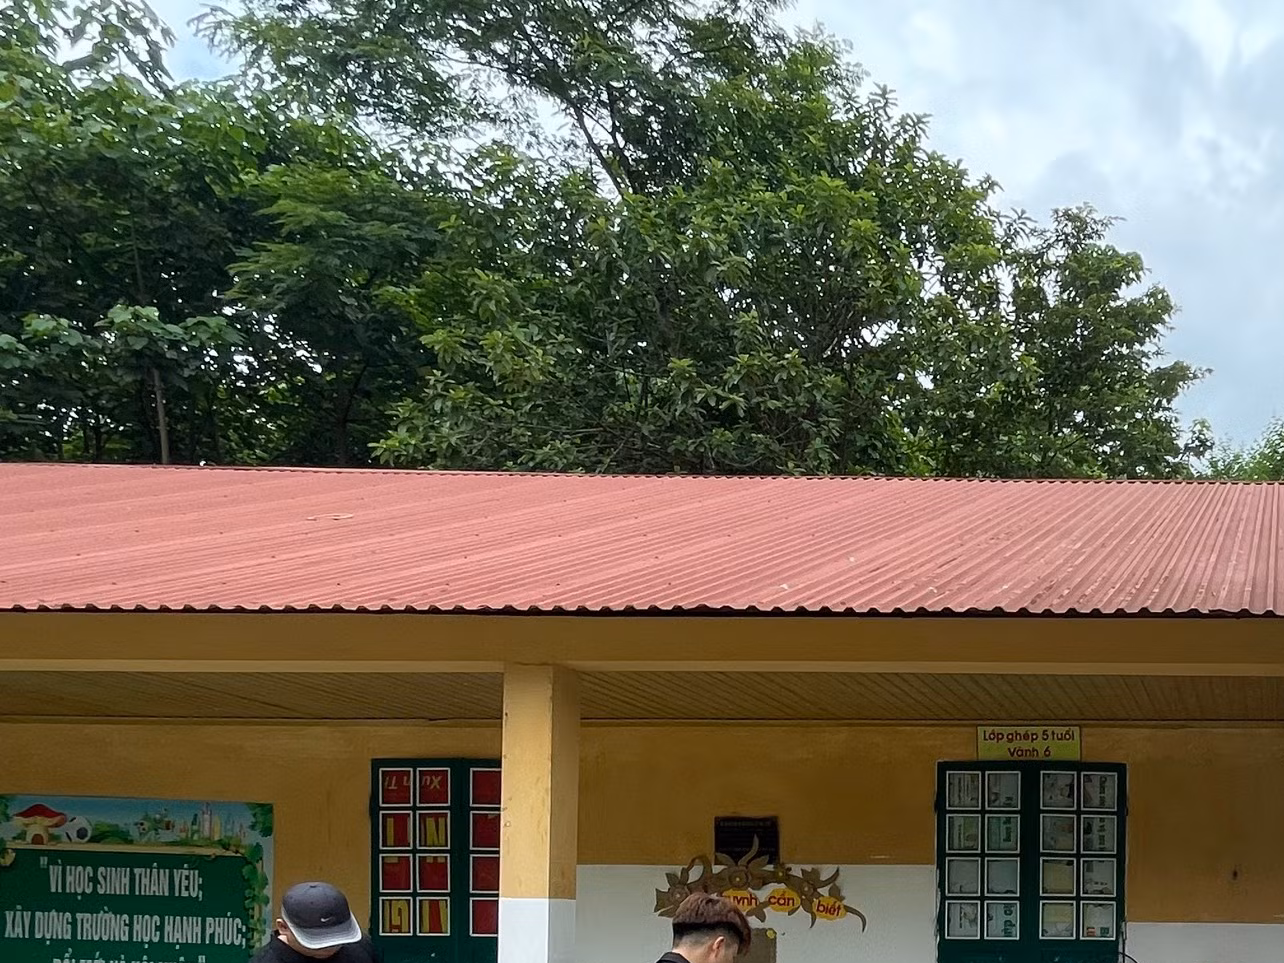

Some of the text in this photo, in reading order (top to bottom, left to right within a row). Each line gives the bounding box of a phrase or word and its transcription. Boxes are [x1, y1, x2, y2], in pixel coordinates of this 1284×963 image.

[1042, 730, 1049, 741] 5
[1043, 746, 1051, 757] 6
[66, 865, 93, 900] HỌC
[97, 867, 130, 895] SINH
[134, 863, 170, 897] THÂN
[174, 864, 203, 901] YÊU;
[4, 905, 247, 950] XÂY DỰNG TRƯỜNG HỌC HẠNH PHÚC;
